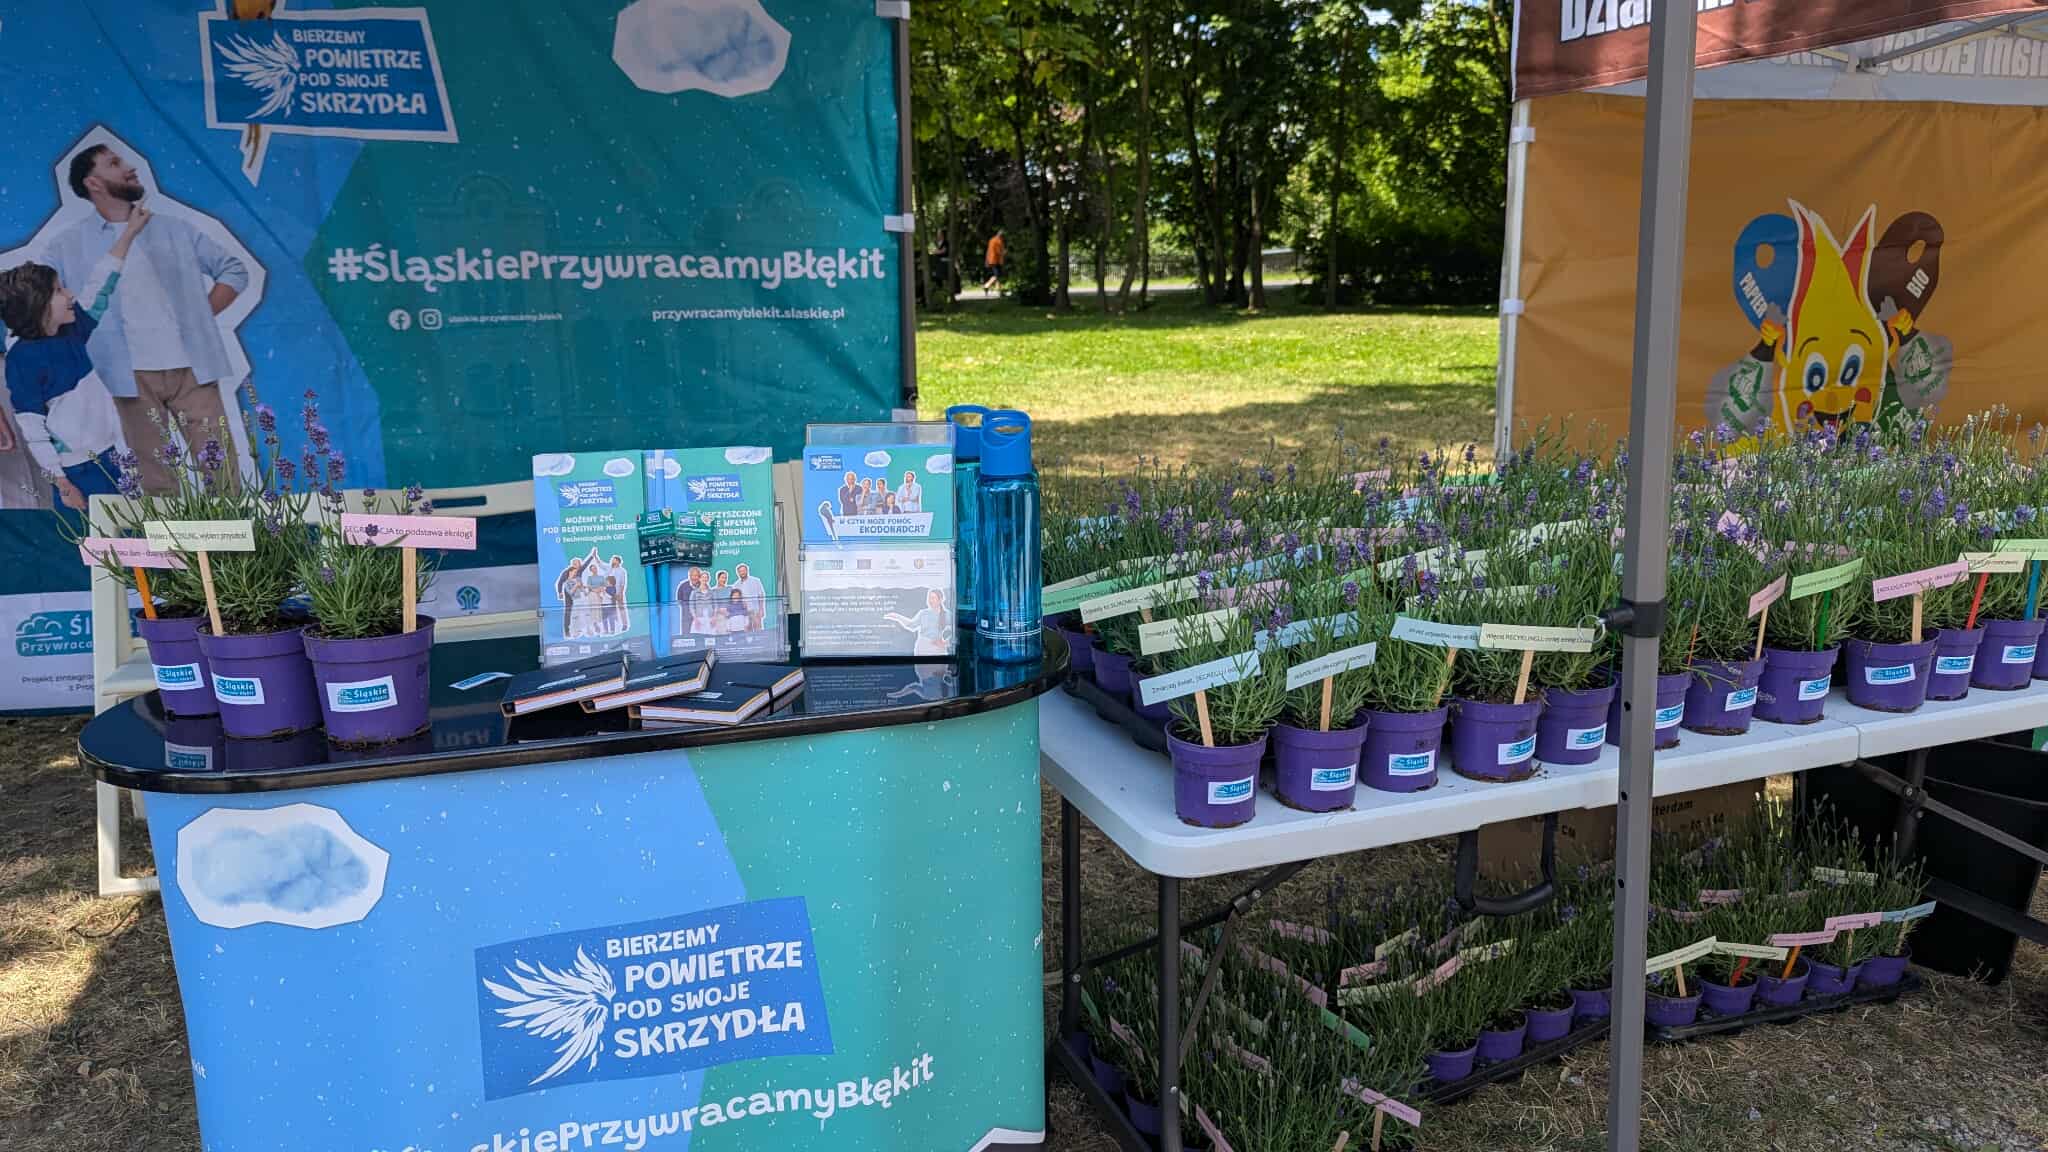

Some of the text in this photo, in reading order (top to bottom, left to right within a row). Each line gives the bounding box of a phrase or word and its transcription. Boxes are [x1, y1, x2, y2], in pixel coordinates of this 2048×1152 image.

[293, 29, 366, 45] BIERZEMY
[306, 49, 422, 70] POWIETRZE
[300, 73, 389, 88] POD SWOJE
[301, 92, 428, 115] SKRZYDŁA
[328, 244, 886, 292] #ŚląskiePrzywracamyBłękit
[1906, 267, 1930, 299] BIO
[1739, 271, 1769, 319] PAPIER
[652, 308, 846, 324] przywracamyblekit.slaskie.pl
[543, 526, 559, 535] POD
[859, 525, 926, 535] EKODORADCA?
[887, 516, 912, 525] POMÓC
[22, 641, 94, 653] Przywraca
[353, 687, 388, 698] Śląskie
[606, 923, 720, 959] BIERZEMY
[625, 941, 803, 993] POWIETRZE
[613, 981, 751, 1021] POD SWOJE
[614, 1001, 806, 1058] SKRZYDŁA
[420, 1052, 935, 1152] skiePrzywracamyBłękit
